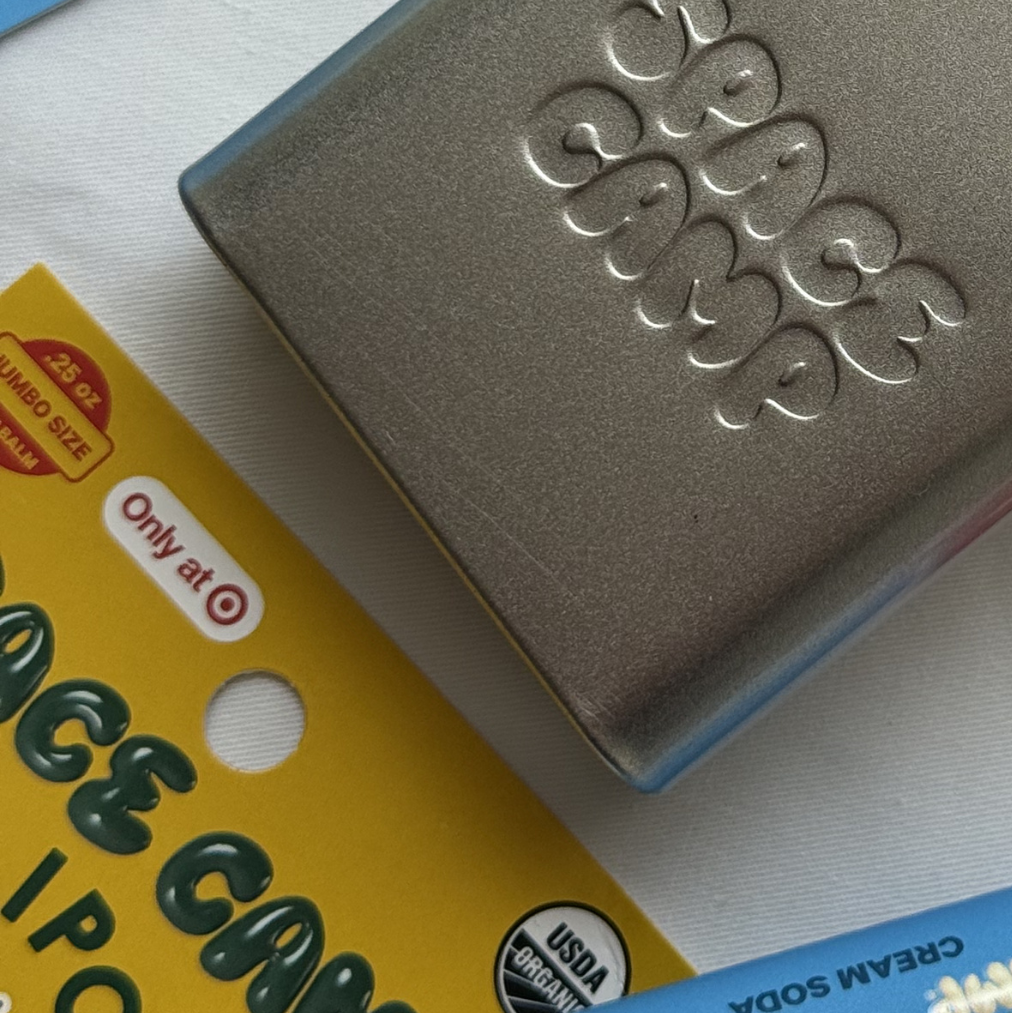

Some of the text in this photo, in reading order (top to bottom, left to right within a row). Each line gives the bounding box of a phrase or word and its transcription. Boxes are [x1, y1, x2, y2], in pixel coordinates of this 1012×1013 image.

[524, 81, 838, 431] CAMP
[43, 352, 102, 410] .25 oz
[48, 415, 92, 462] SIZE
[122, 493, 215, 592] Only at
[547, 922, 610, 994] USDA
[728, 935, 964, 1013] CREAM SODA
